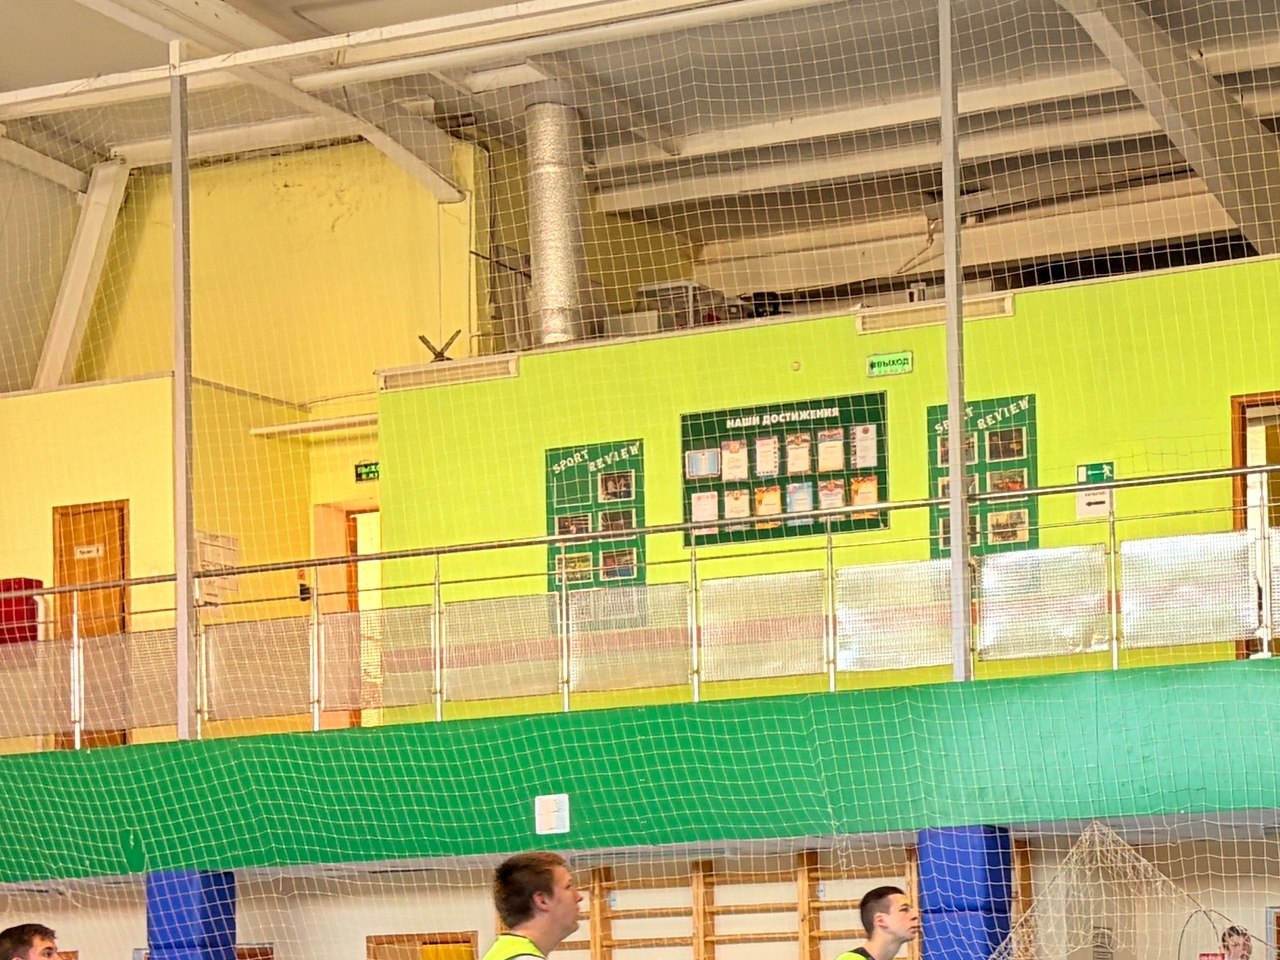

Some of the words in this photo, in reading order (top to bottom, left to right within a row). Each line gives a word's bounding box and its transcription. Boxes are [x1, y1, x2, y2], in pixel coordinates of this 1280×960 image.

[876, 357, 909, 369] ВЫХОД
[726, 416, 762, 429] НАШИ
[763, 406, 840, 426] ДОСТИЖЕНИЯ
[977, 396, 1030, 431] REVIEW
[552, 449, 589, 474] SPORT
[588, 441, 640, 472] REVIEW
